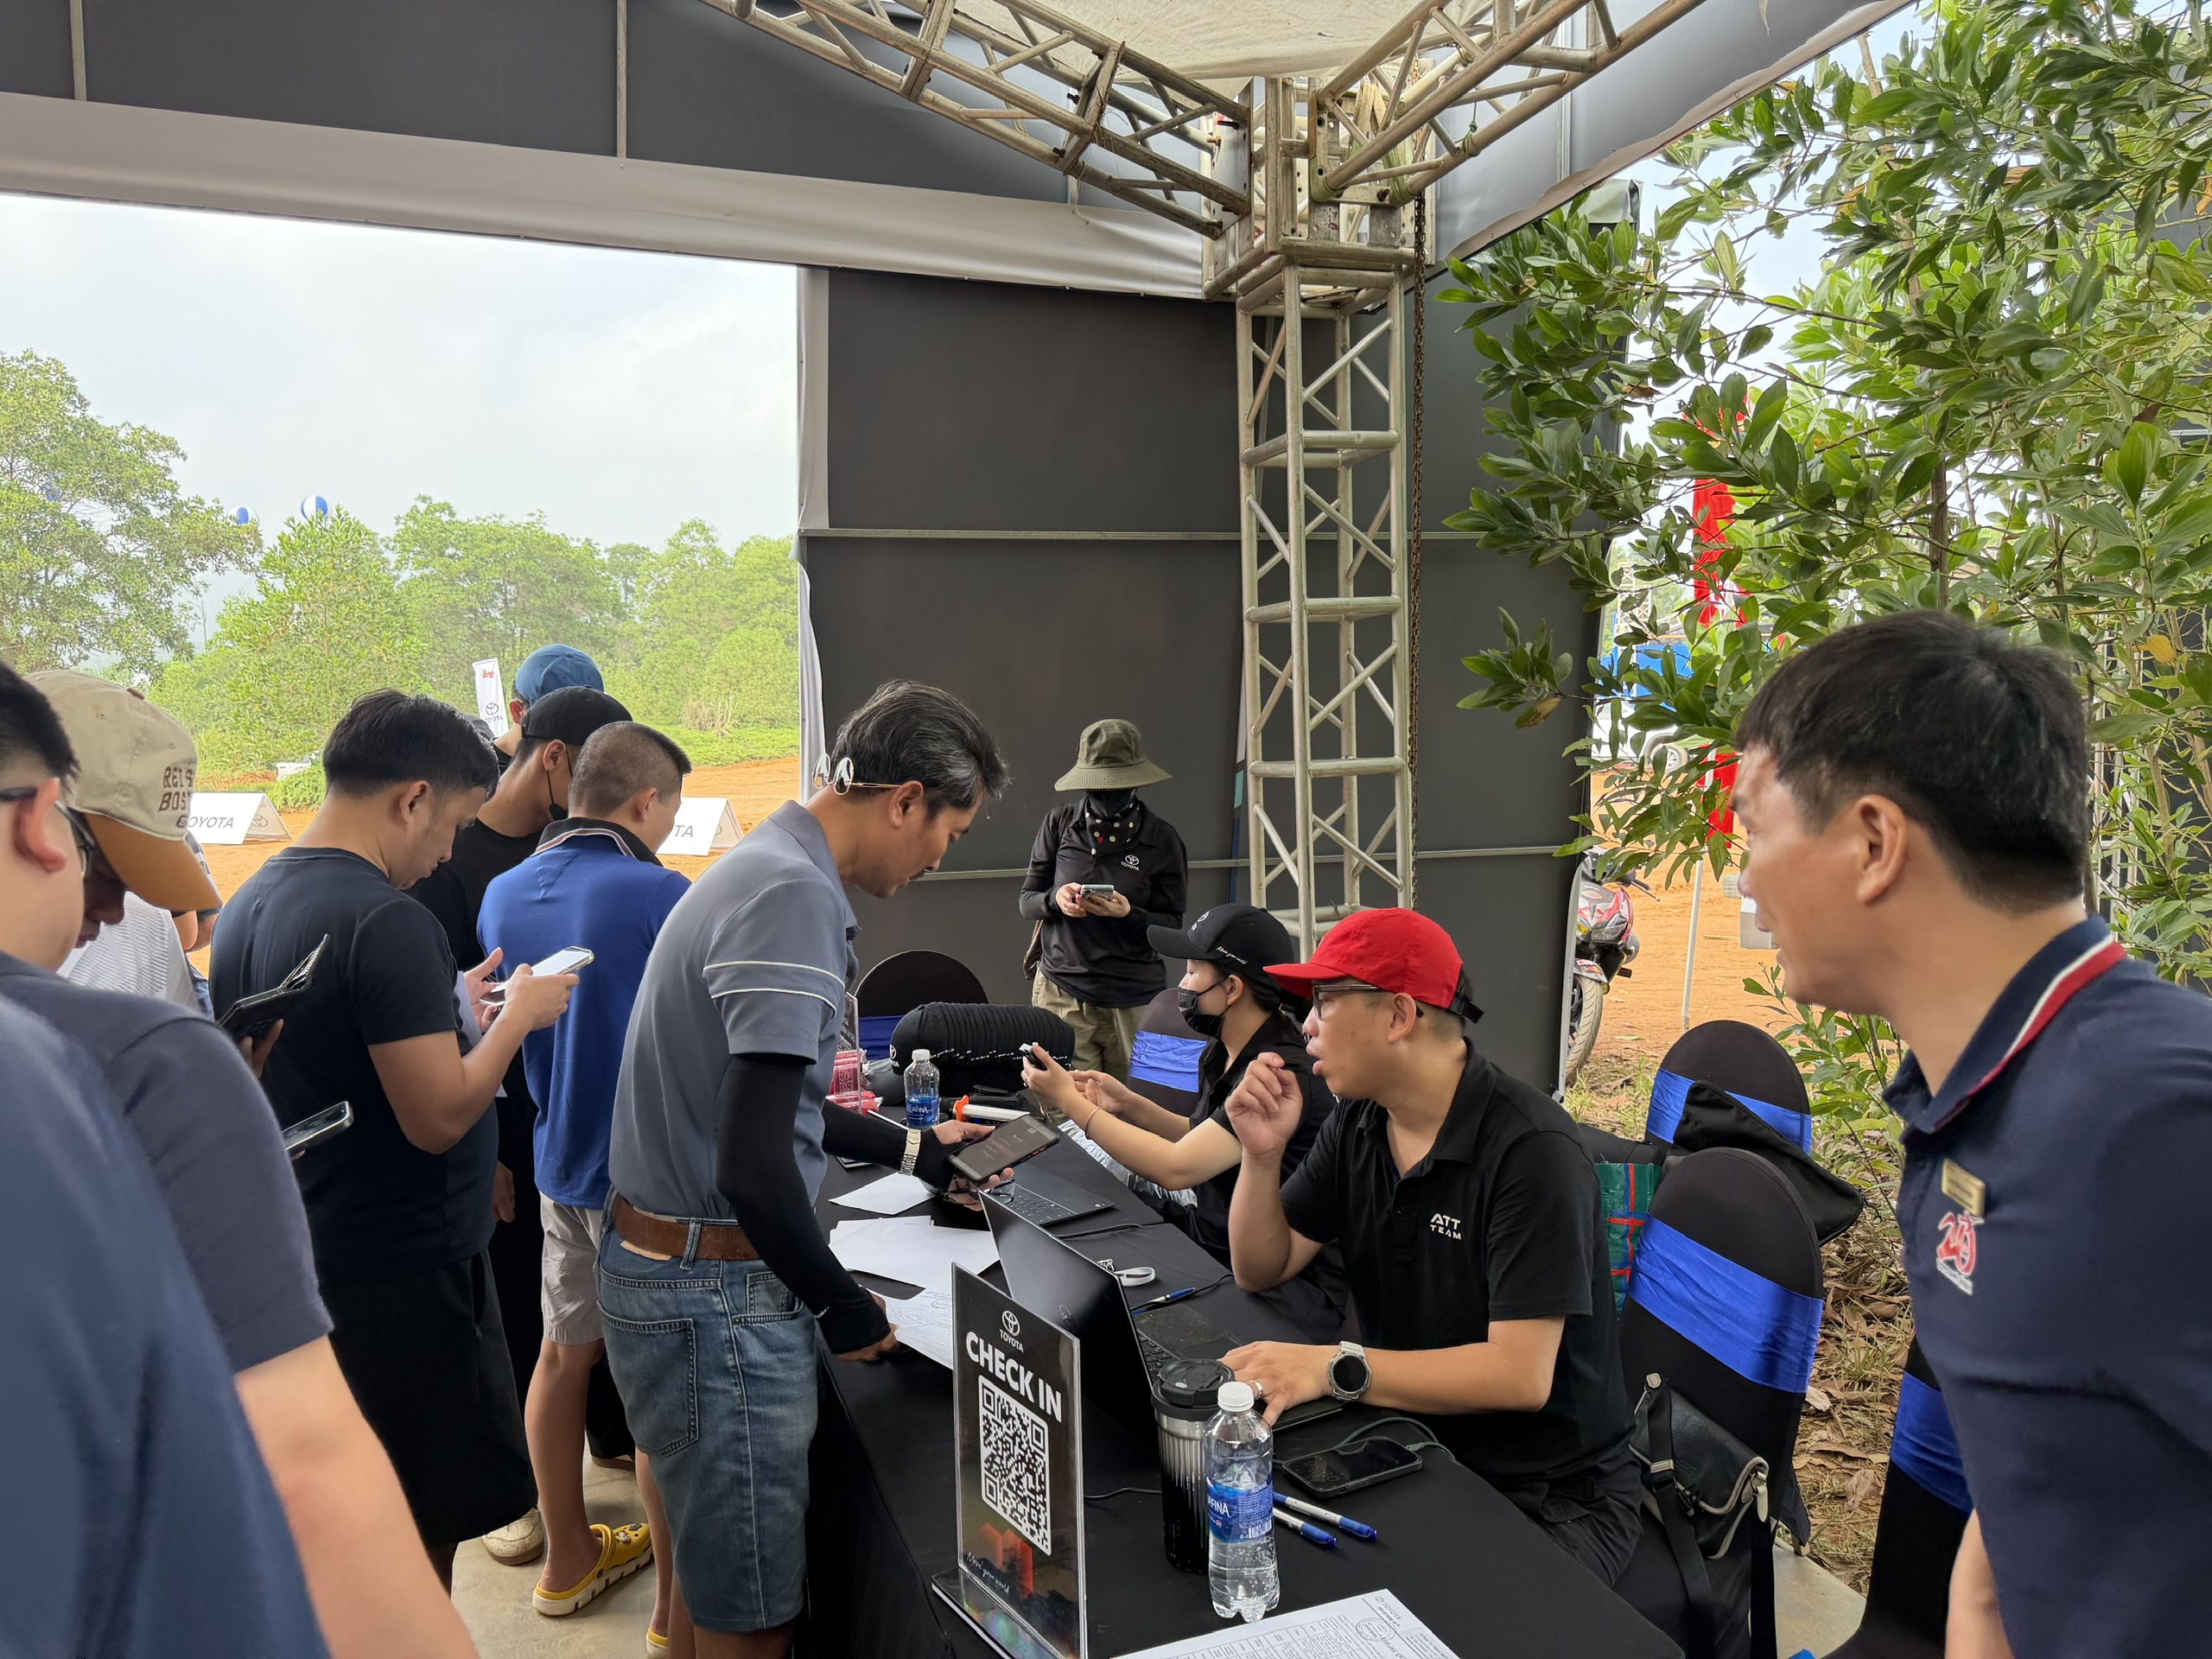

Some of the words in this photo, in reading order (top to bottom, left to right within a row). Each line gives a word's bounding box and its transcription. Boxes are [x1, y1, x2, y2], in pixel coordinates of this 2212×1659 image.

[188, 817, 234, 829] OYOTA
[675, 825, 694, 837] TA
[1121, 861, 1140, 871] TOYOTA
[1430, 1212, 1461, 1230] ATT
[1429, 1224, 1462, 1240] TEAM
[999, 1329, 1024, 1353] TOYOTA
[966, 1331, 1034, 1403] CHECK
[1039, 1377, 1062, 1423] IN
[967, 1551, 982, 1569] Move
[982, 1567, 995, 1578] your
[1382, 1602, 1402, 1620] TOYOTA
